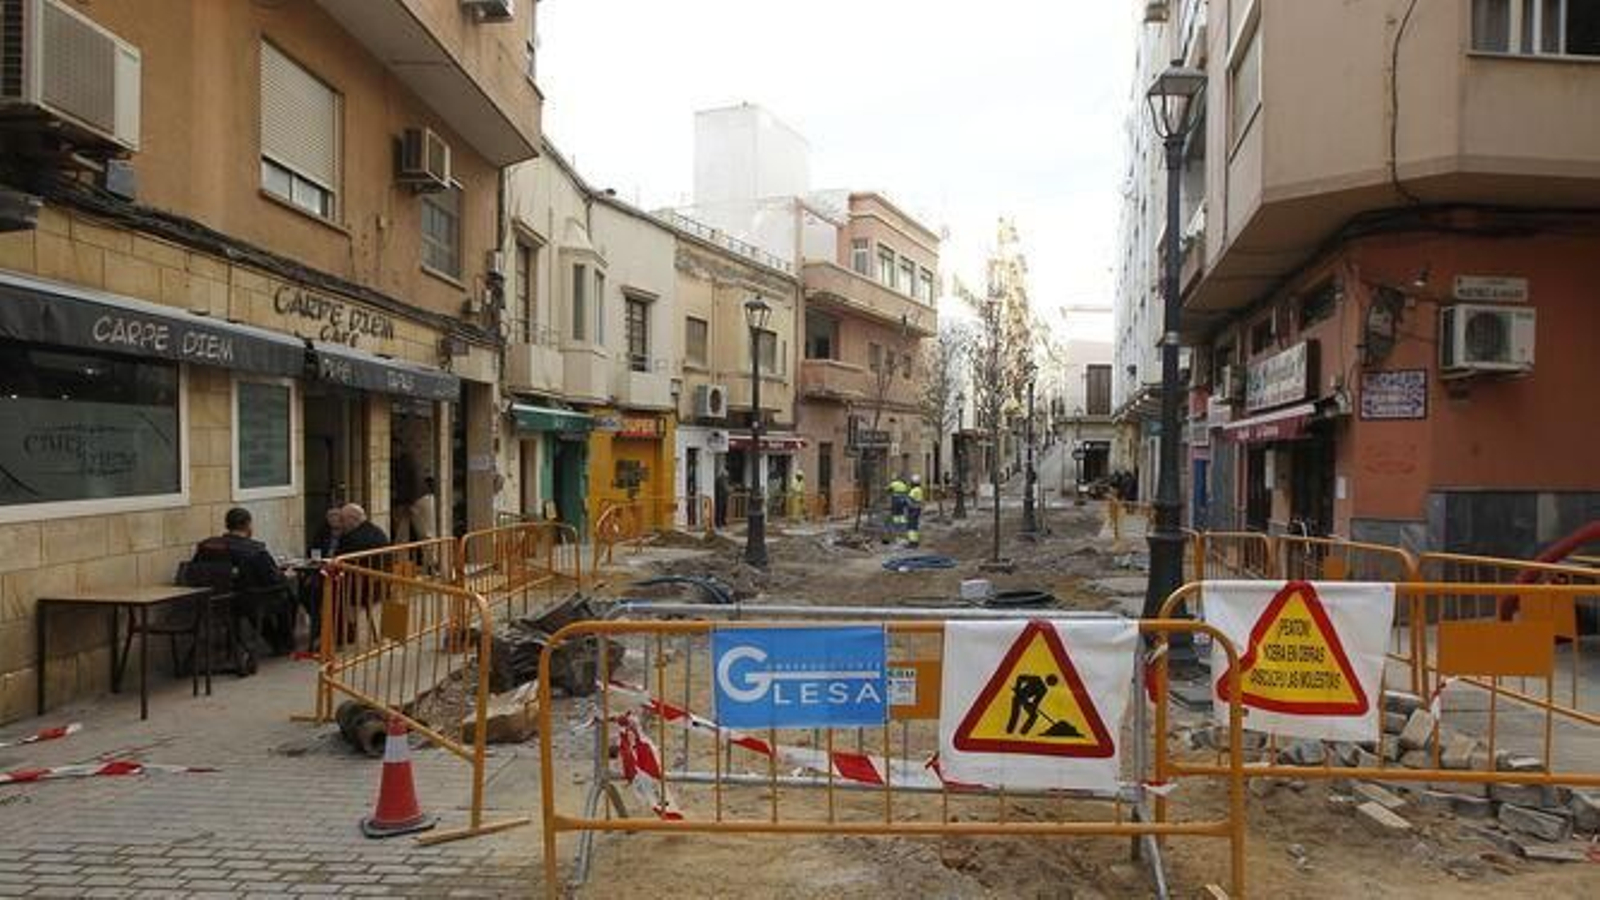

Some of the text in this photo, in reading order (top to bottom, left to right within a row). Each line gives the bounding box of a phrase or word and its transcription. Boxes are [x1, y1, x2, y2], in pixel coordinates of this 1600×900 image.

[92, 315, 234, 361] CARPE DIEM
[274, 285, 394, 341] CARPE DIEM
